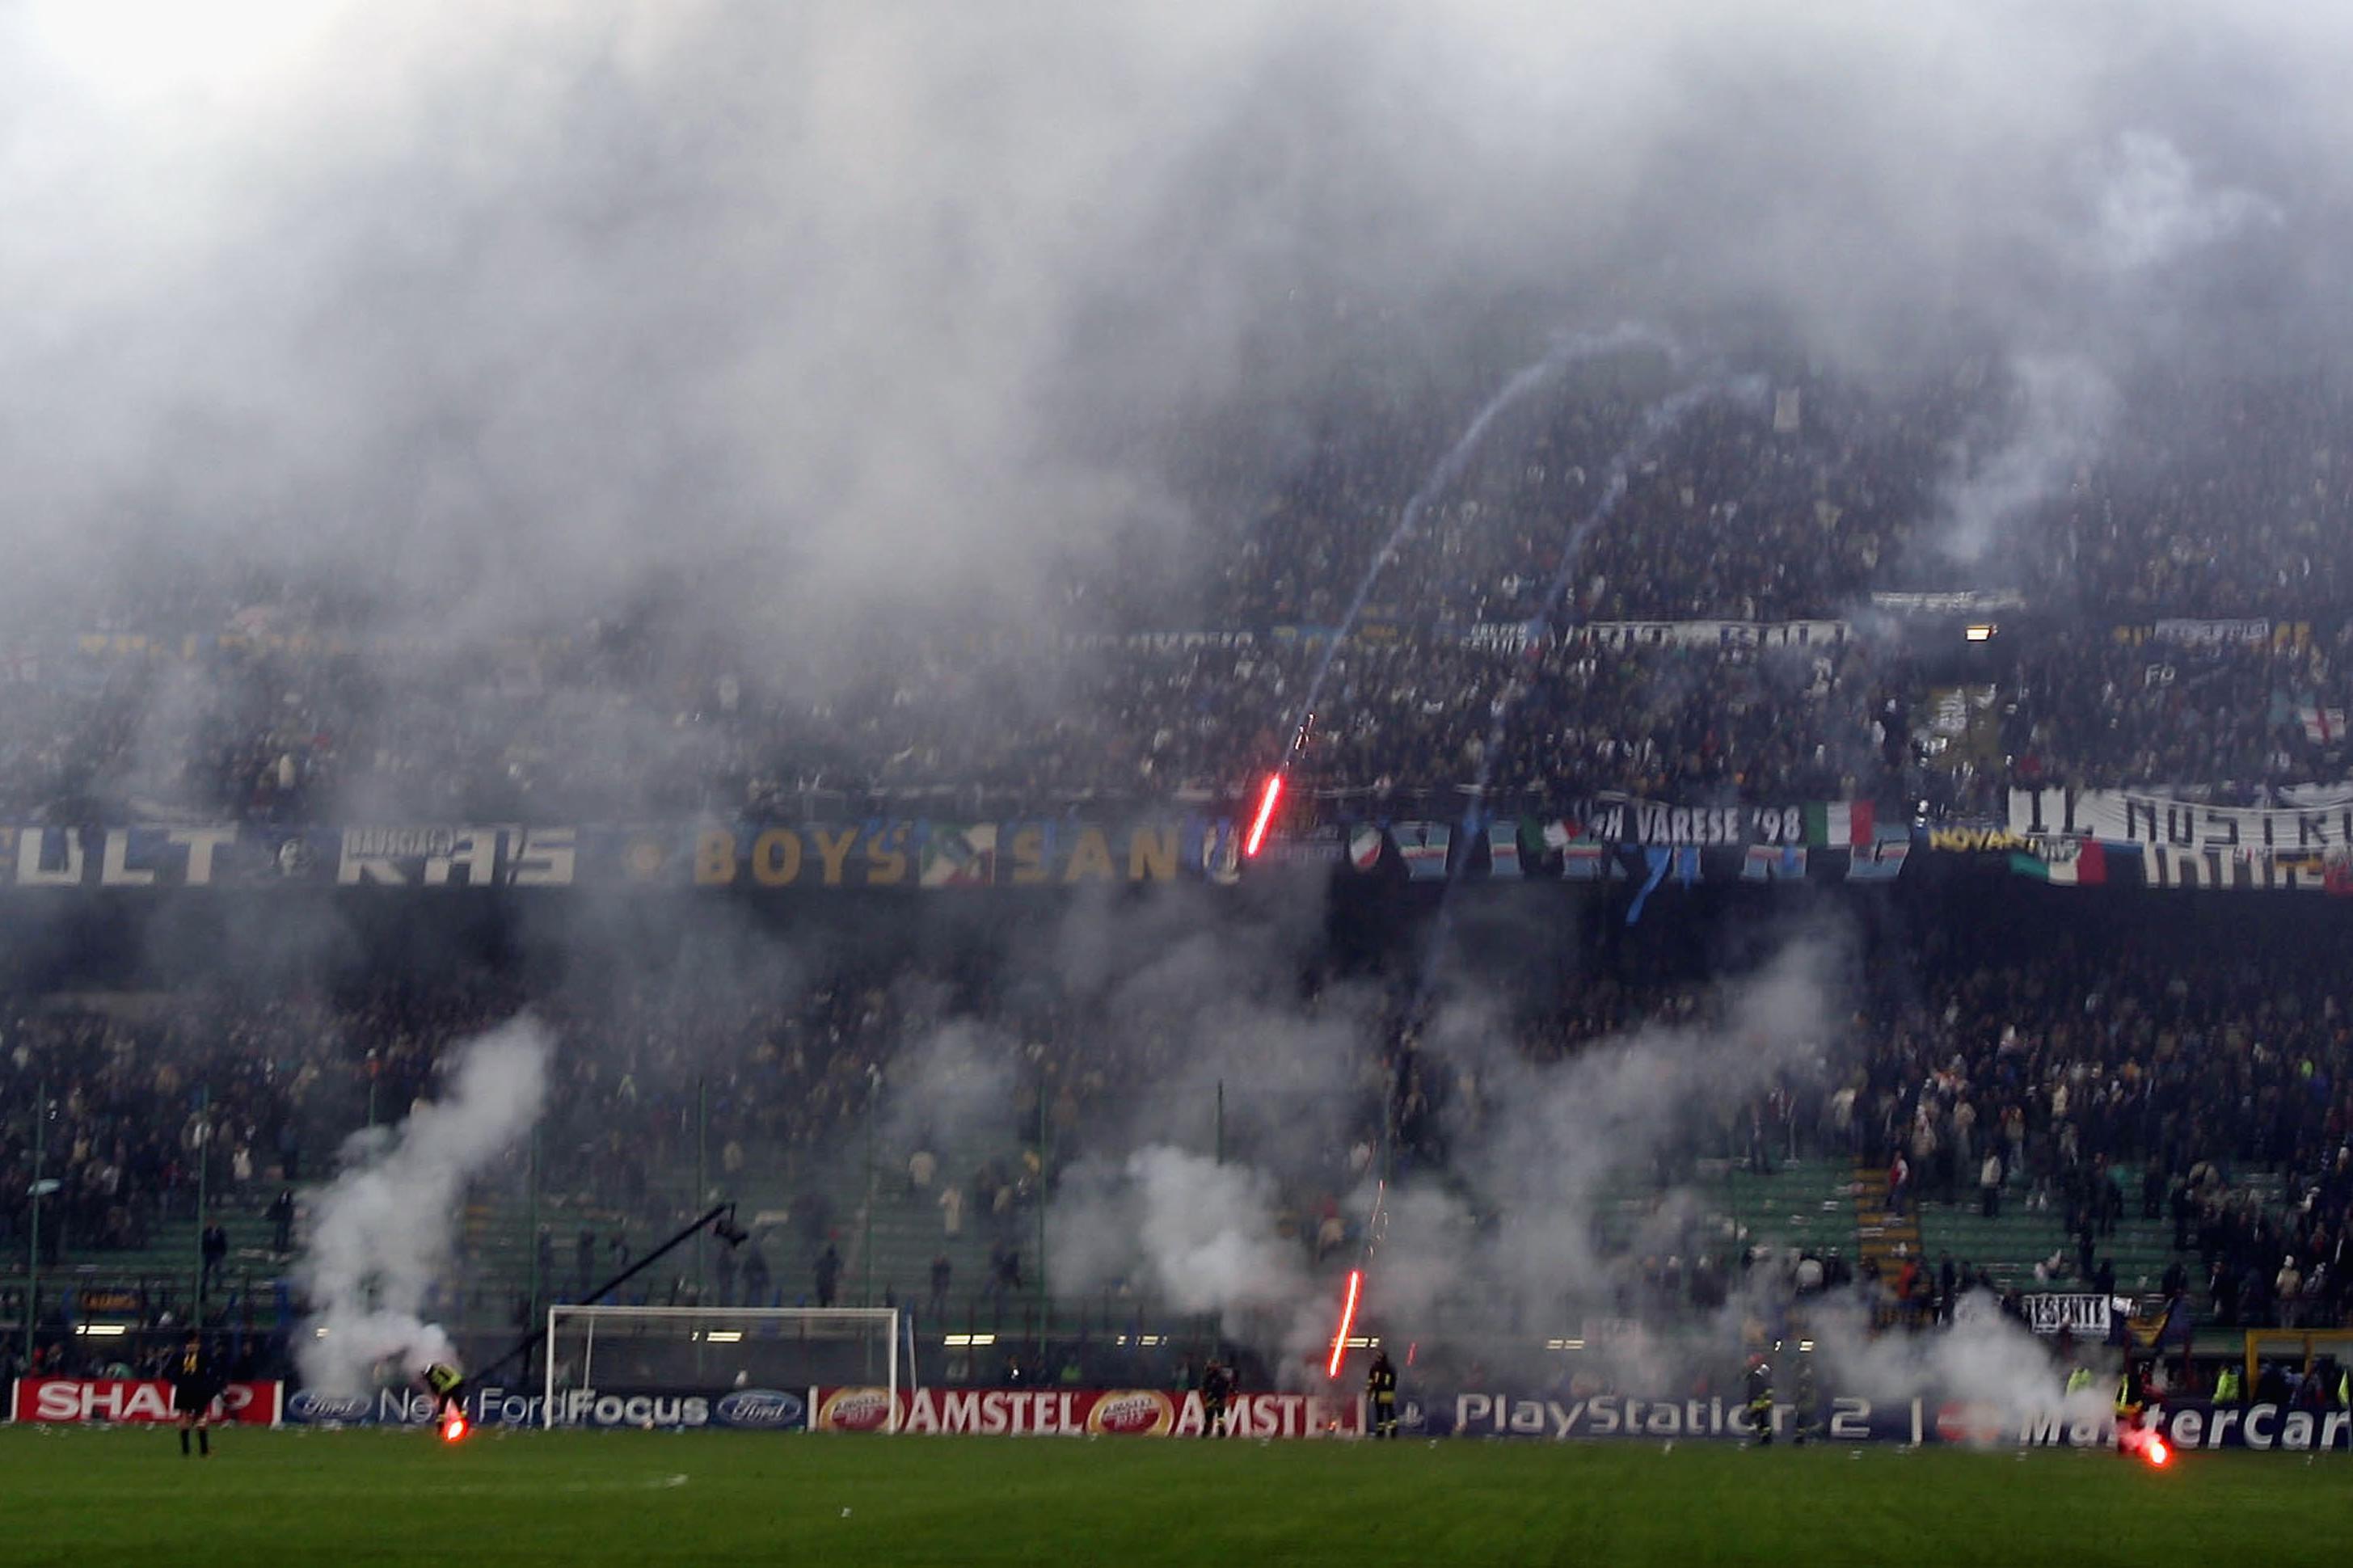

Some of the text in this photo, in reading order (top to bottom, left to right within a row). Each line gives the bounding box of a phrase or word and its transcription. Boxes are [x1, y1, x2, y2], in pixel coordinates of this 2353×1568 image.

[1636, 807, 1740, 845] VARESE
[378, 1378, 470, 1423] Ne
[905, 1388, 1083, 1436] AMSTEL
